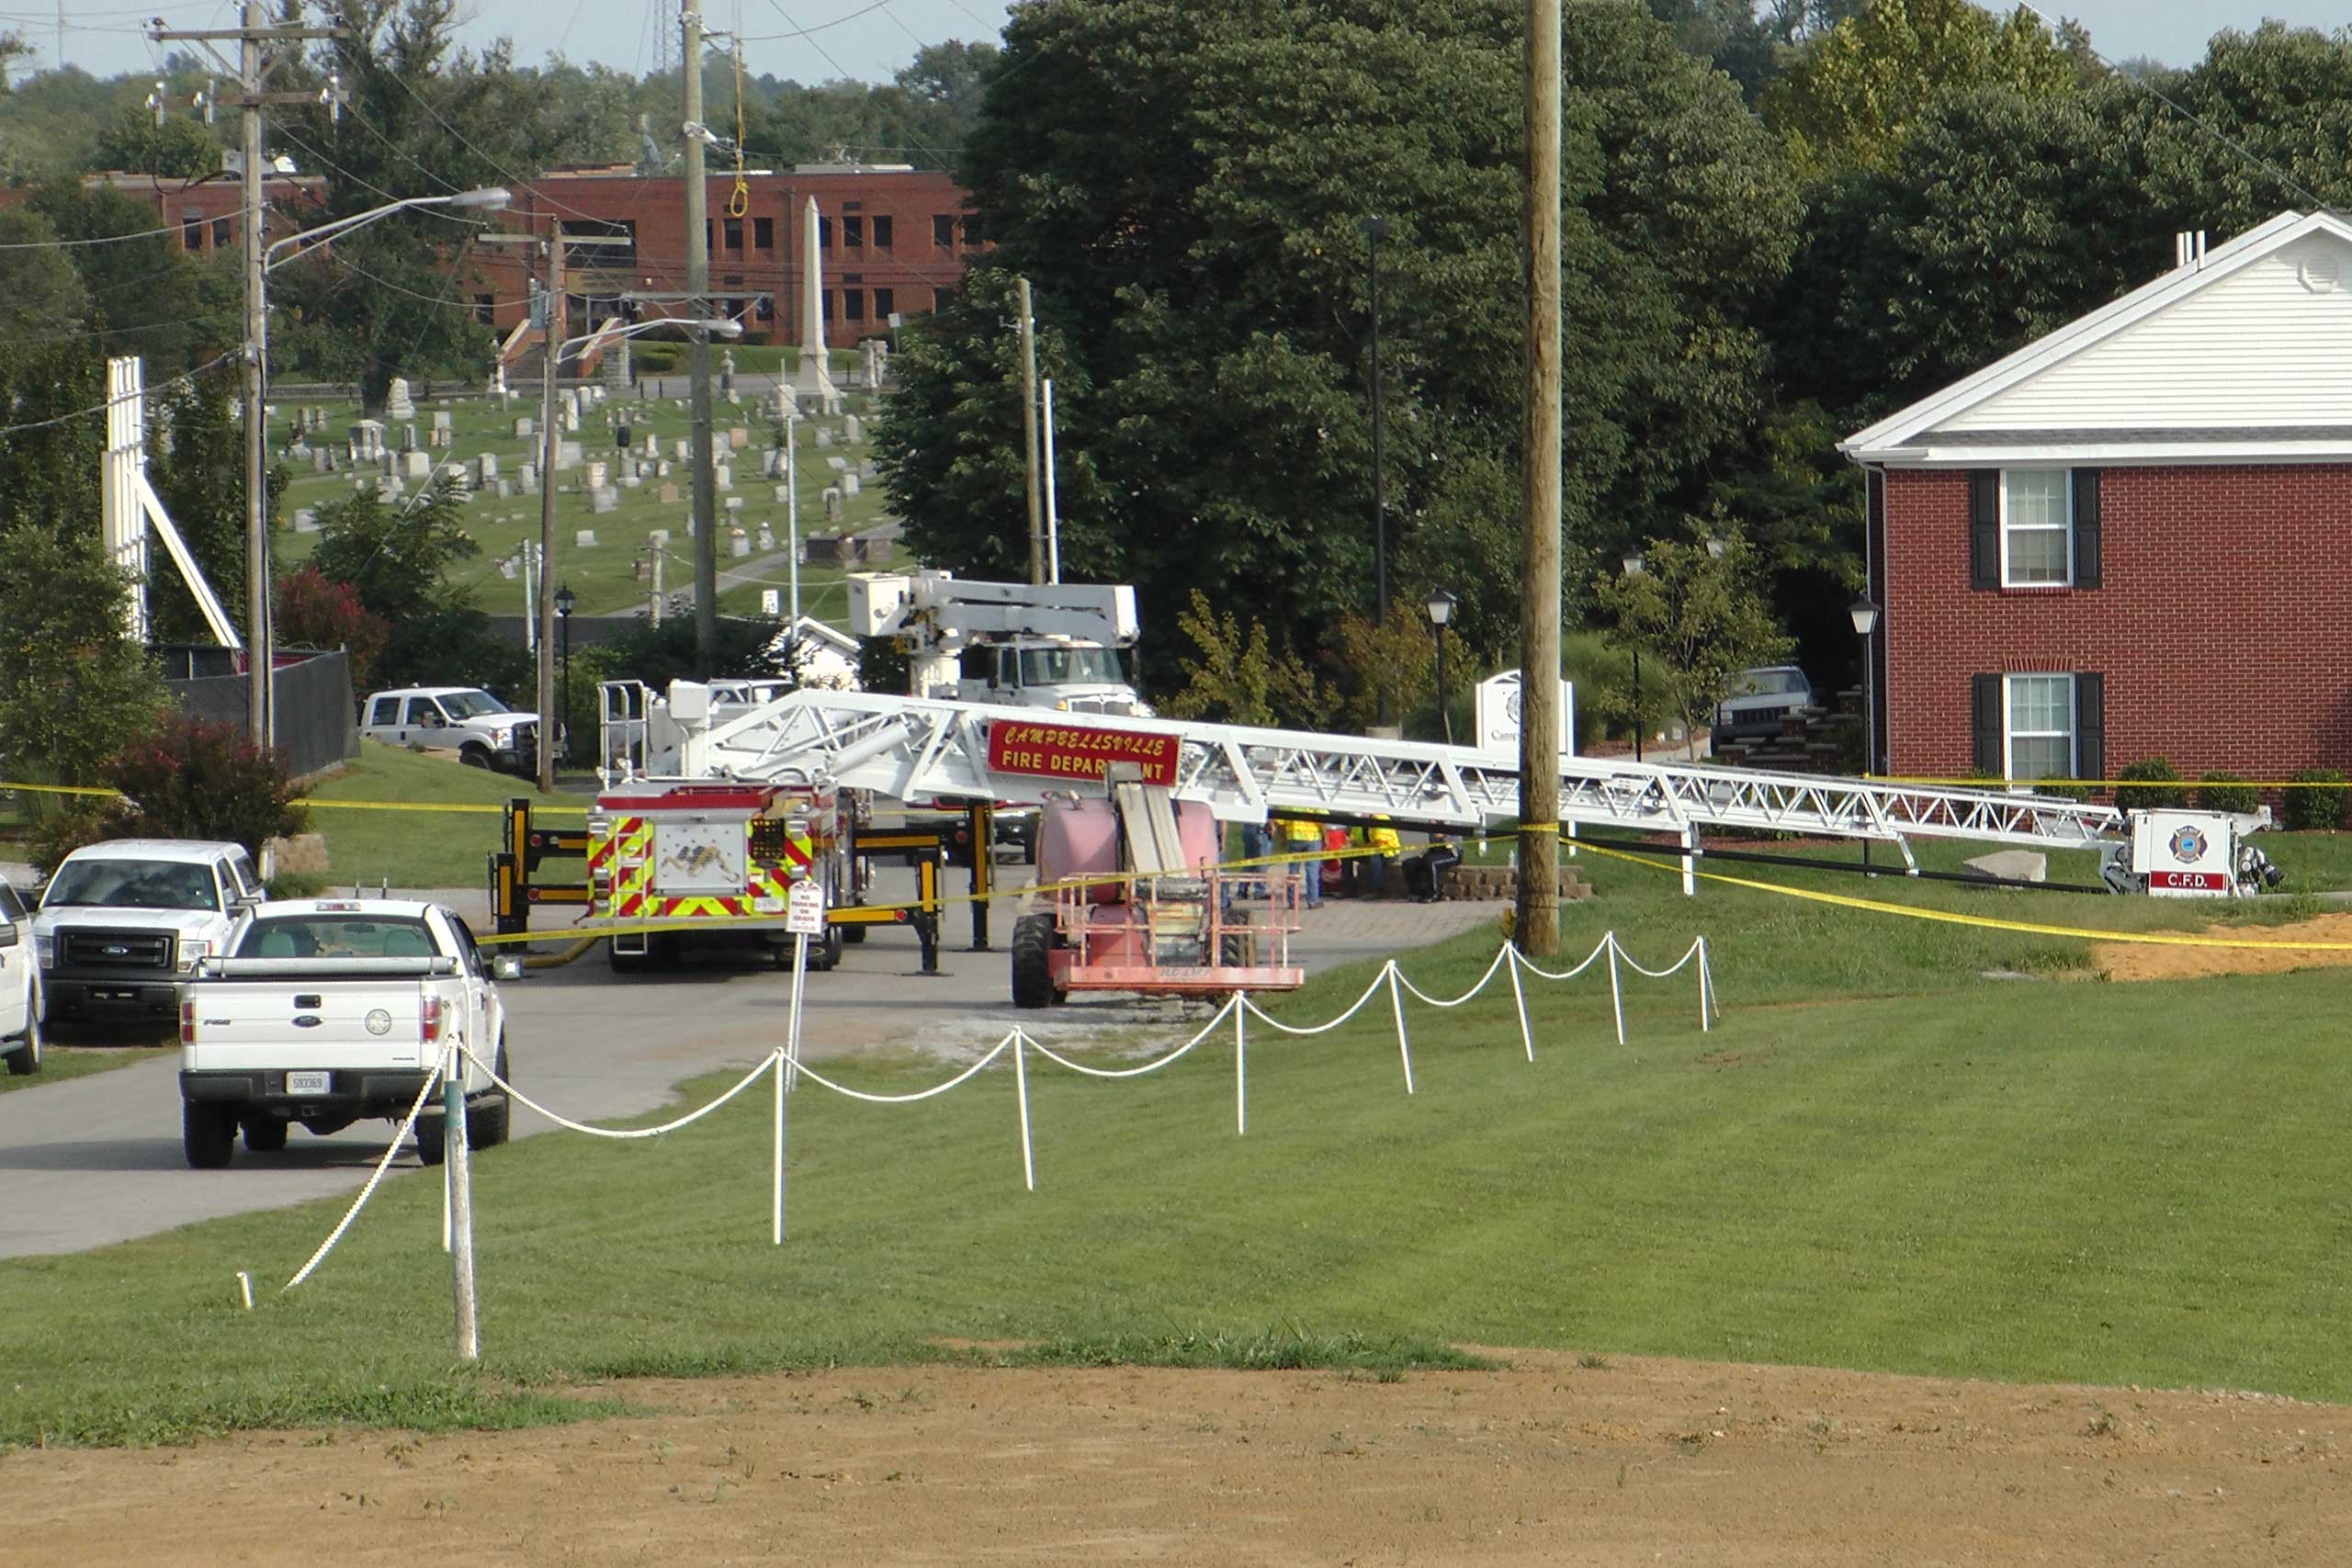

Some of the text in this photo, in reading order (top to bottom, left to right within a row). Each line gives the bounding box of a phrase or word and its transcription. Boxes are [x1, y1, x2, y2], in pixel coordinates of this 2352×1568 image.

[1004, 726, 1165, 756] CAMPBELLSVILLE
[1001, 750, 1164, 780] FIRE DEPARNT
[2167, 874, 2208, 887] C.F.D.
